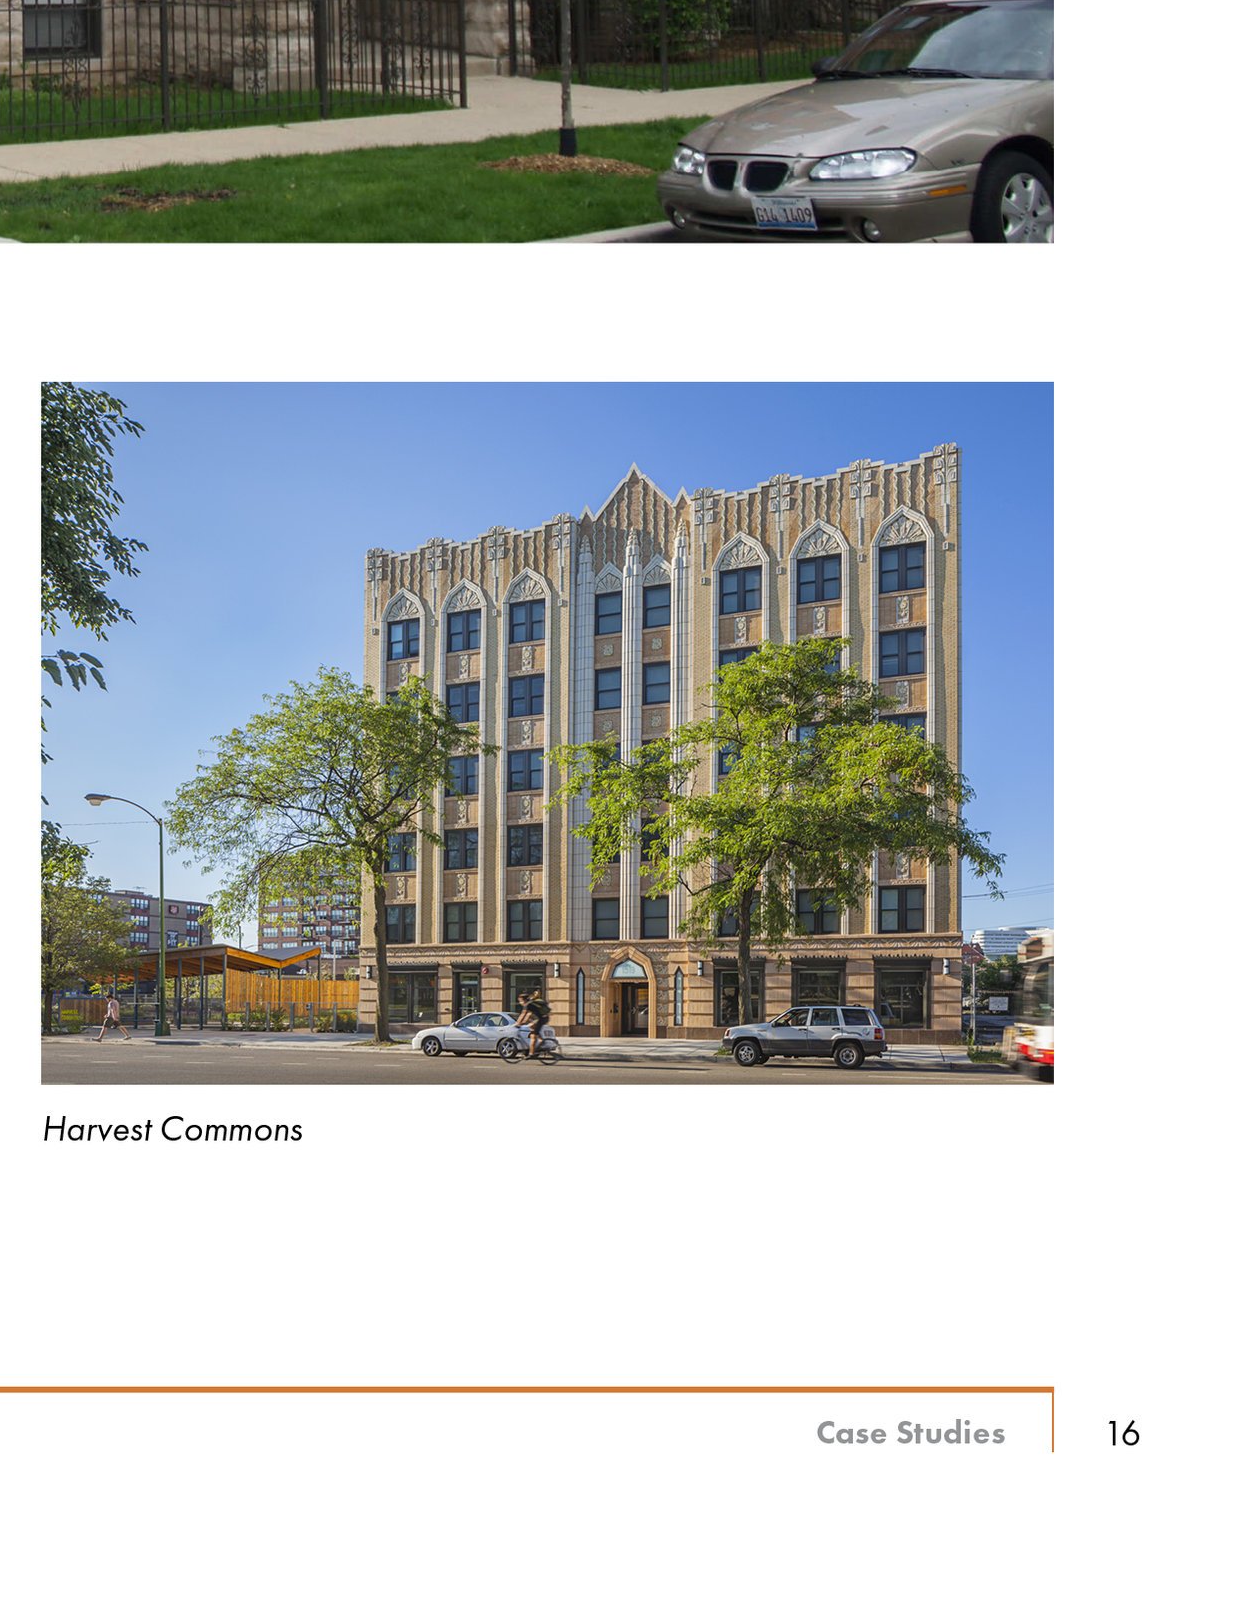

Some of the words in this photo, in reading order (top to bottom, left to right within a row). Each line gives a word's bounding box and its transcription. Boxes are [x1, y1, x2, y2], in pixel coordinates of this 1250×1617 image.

[43, 1115, 154, 1143] Harvest
[160, 1115, 303, 1142] Commons
[816, 1420, 887, 1445] Case
[896, 1418, 1006, 1445] Studies
[1108, 1419, 1141, 1447] 16
